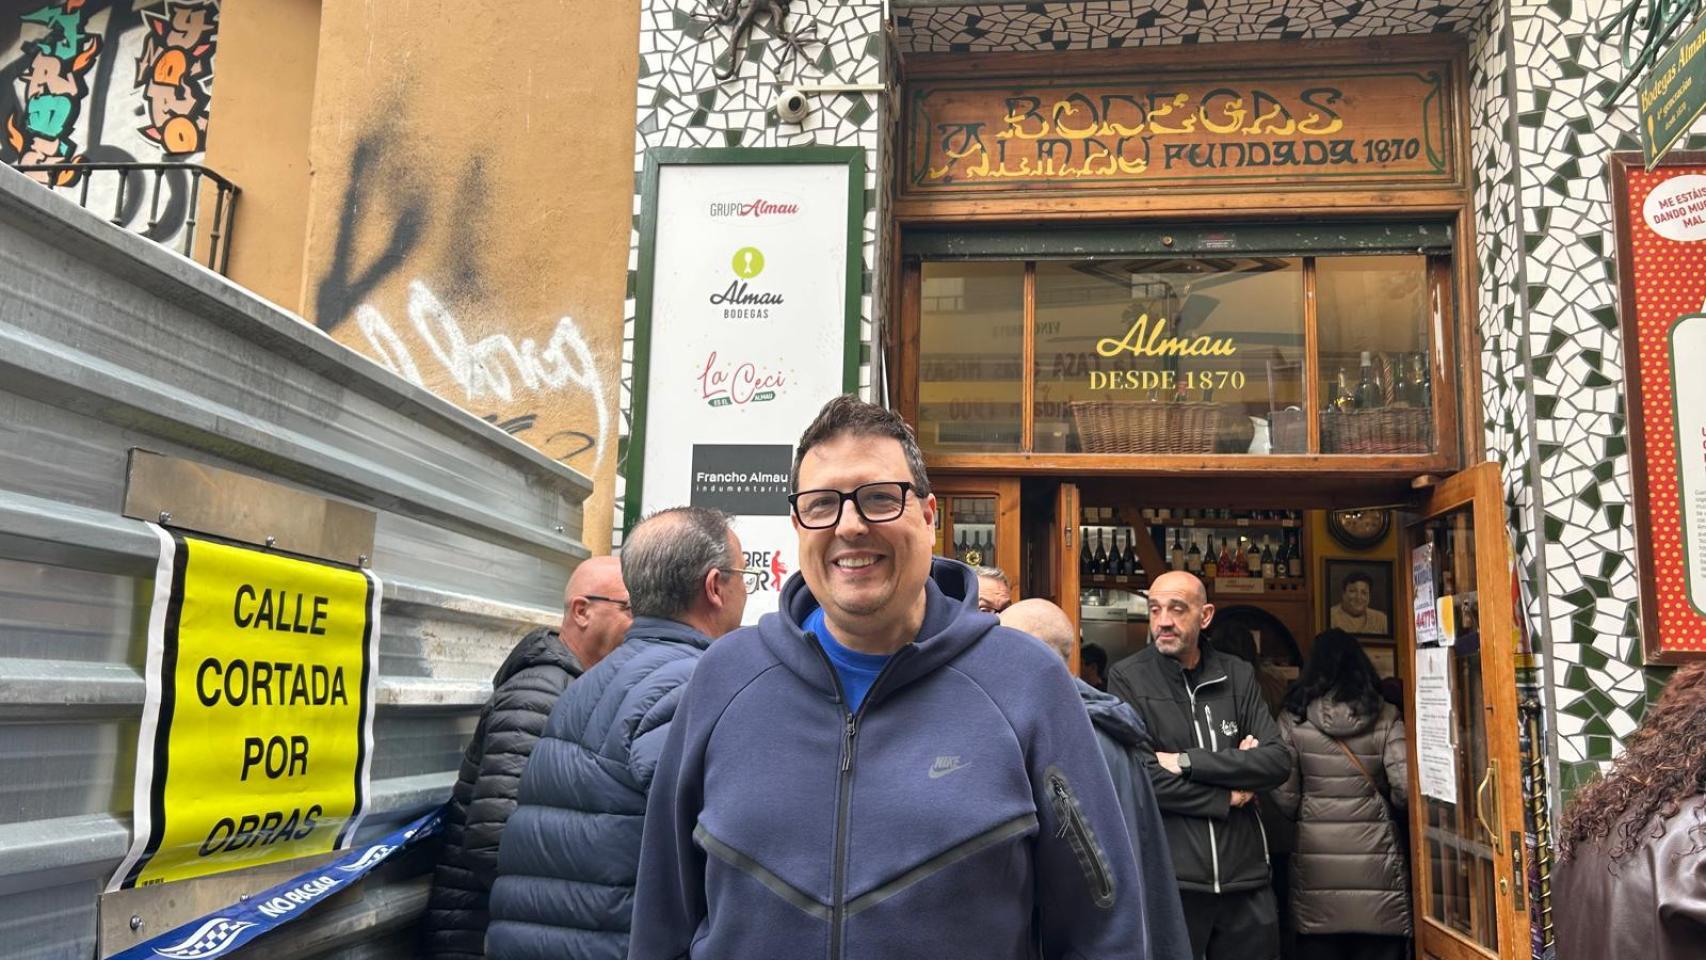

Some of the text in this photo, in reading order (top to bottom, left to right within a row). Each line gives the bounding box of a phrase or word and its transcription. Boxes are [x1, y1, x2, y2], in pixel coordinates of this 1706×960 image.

[1642, 63, 1677, 114] Bodegas
[996, 86, 1344, 140] BODEGAS
[1163, 139, 1358, 169] FUNDADA
[1363, 137, 1420, 163] 1870
[710, 199, 800, 217] GRUPO Almau
[1658, 187, 1706, 209] ME ESTÁIS
[1653, 207, 1687, 224] DANDO
[710, 280, 784, 305] Almau
[723, 308, 769, 319] BODEGAS
[1096, 313, 1237, 357] Almau
[697, 351, 786, 405] La Ceci
[1088, 370, 1246, 390] DESDE 1870
[696, 471, 789, 483] Francho Almau
[696, 484, 787, 493] indumentaria
[742, 551, 771, 568] BRE
[234, 584, 329, 636] CALLE
[196, 657, 348, 706] CORTADA
[240, 735, 309, 781] POR
[934, 755, 961, 769] NIKE
[199, 803, 323, 857] OBRAS
[257, 875, 345, 919] NO PASAR
